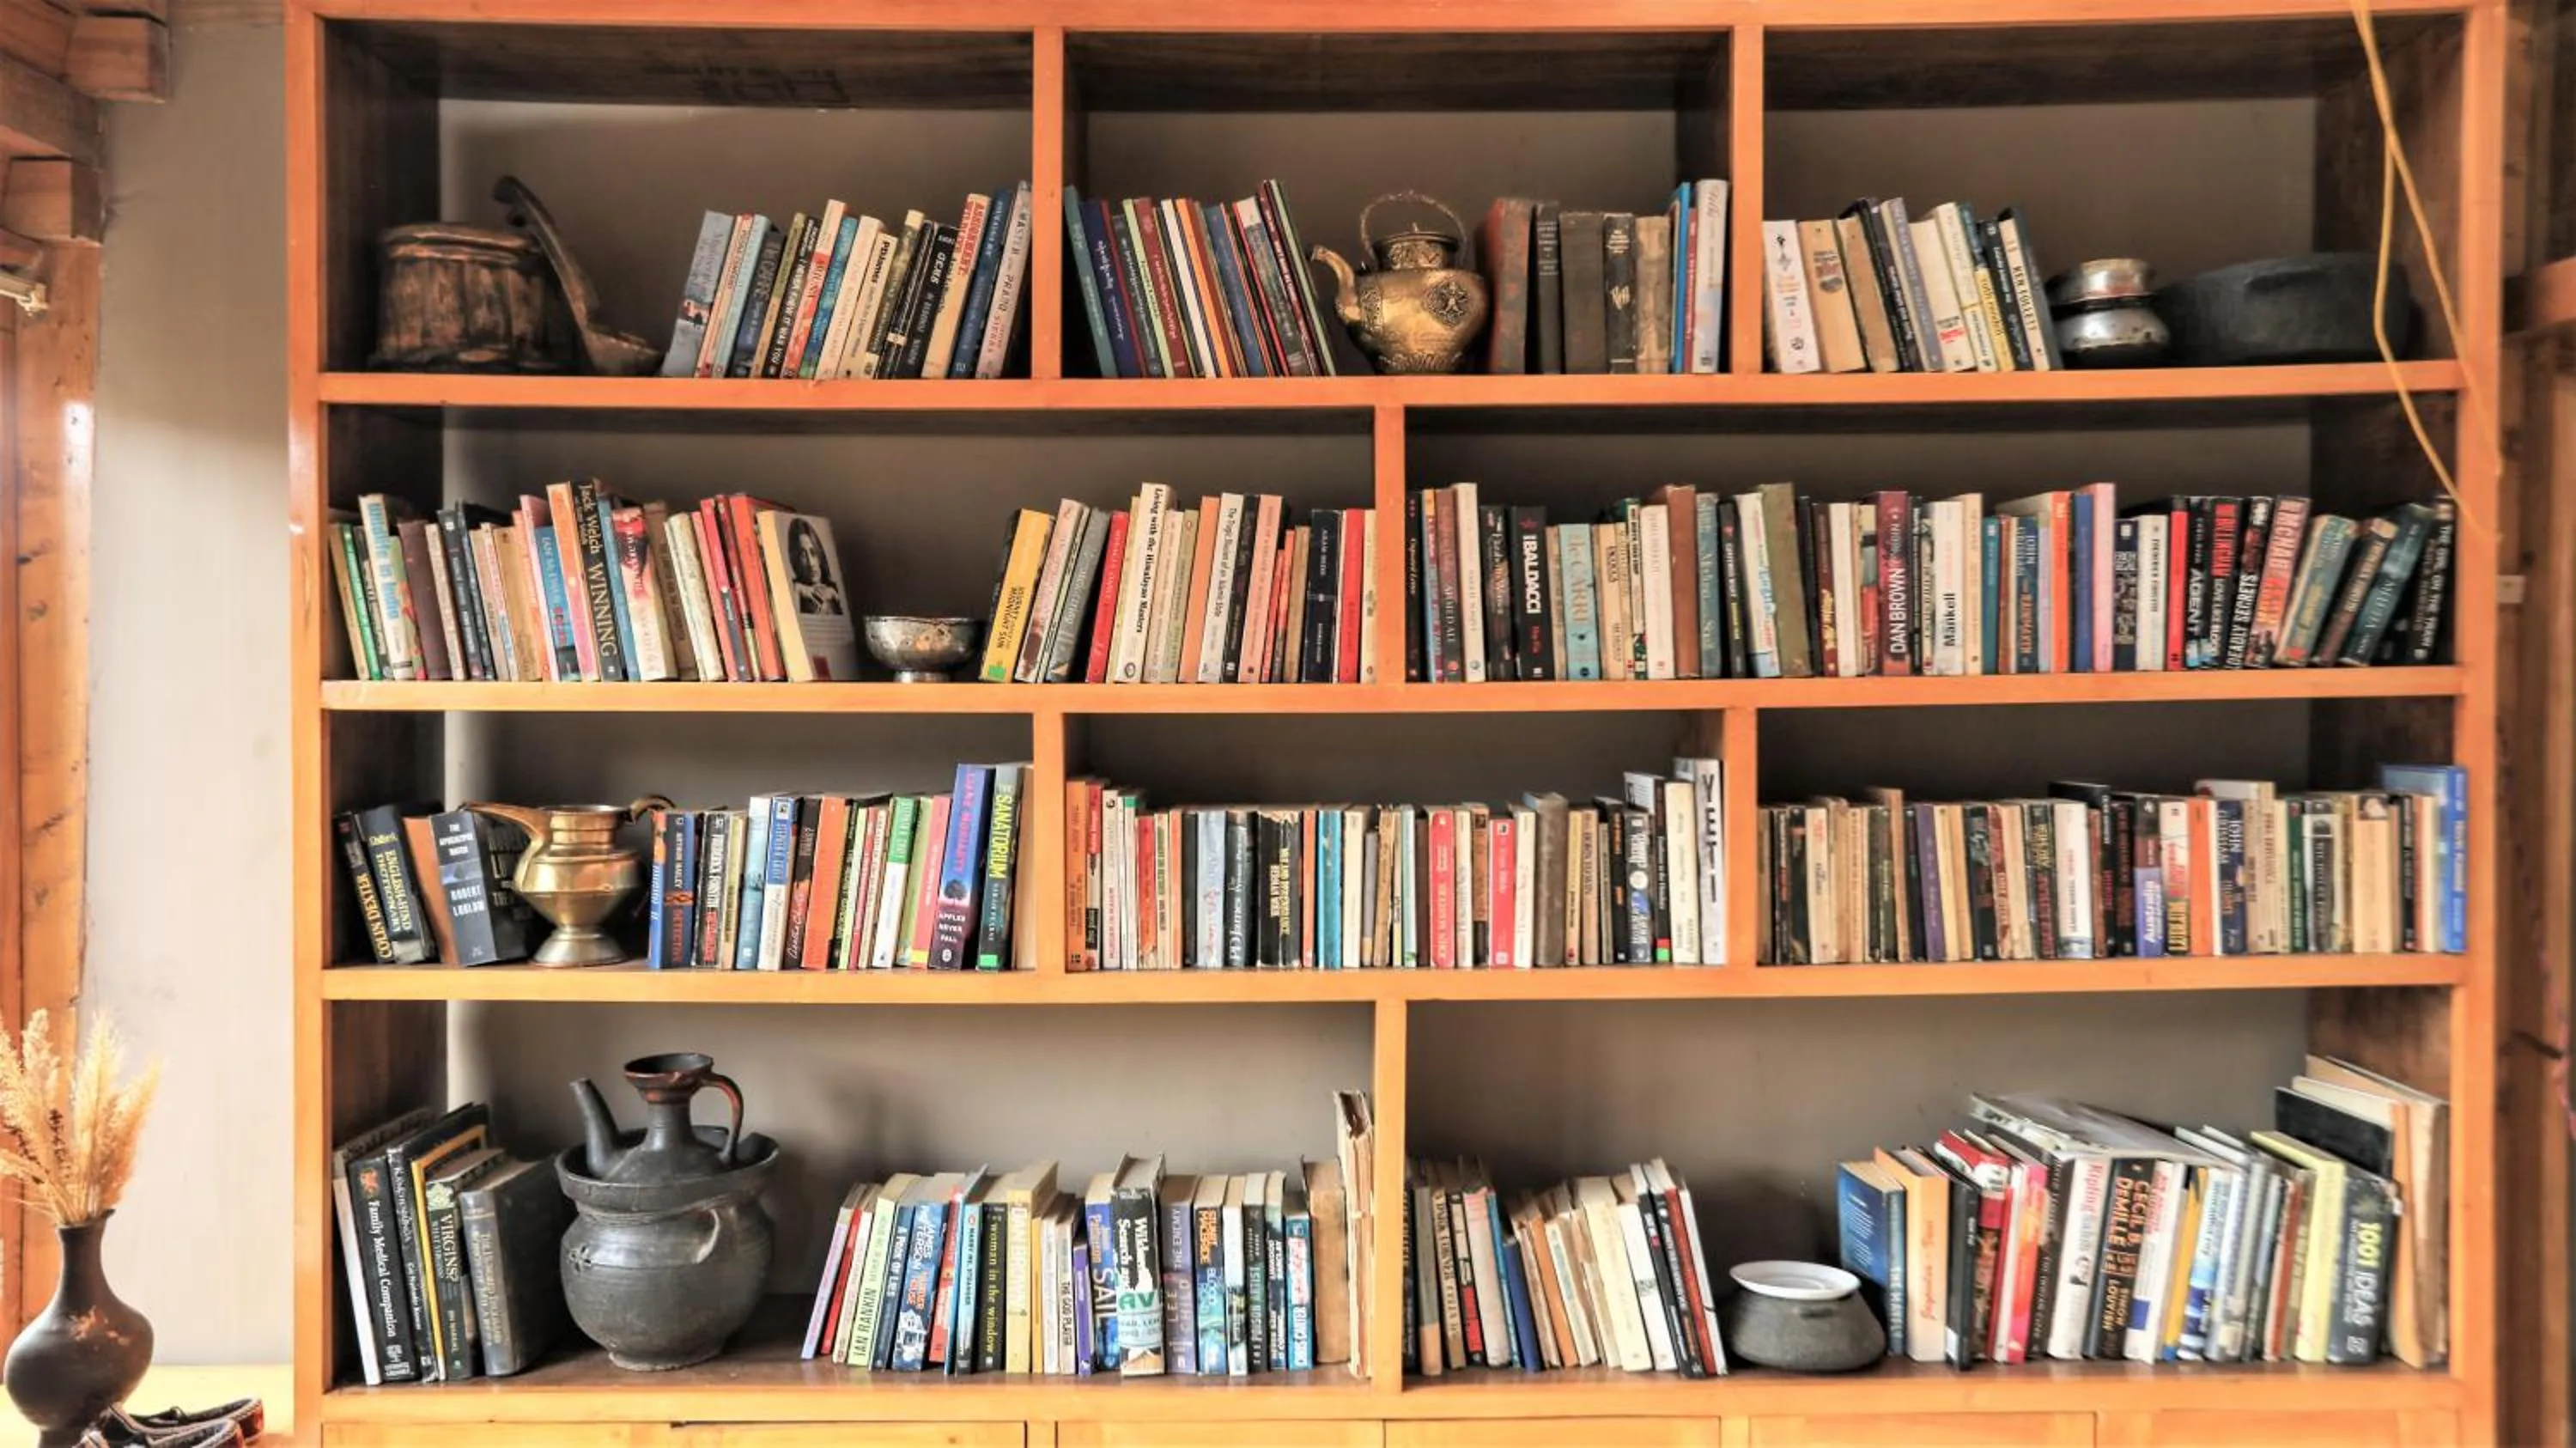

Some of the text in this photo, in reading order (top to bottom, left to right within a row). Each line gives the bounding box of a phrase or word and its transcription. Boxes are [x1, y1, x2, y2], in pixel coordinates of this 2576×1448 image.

[771, 347, 783, 364] YOU
[579, 484, 603, 555] Jack Welch
[1148, 515, 1162, 536] with
[1150, 486, 1165, 514] Living
[1139, 554, 1157, 599] Himalayan
[2026, 534, 2037, 565] JOHN
[1522, 540, 1542, 615] BALDACCI
[2187, 567, 2203, 636] AGENT
[2233, 573, 2258, 624] SECRETS
[588, 562, 617, 657] WINNING
[1135, 599, 1149, 634] Masters
[1443, 583, 1457, 642] AHMED ALI
[1888, 568, 1907, 654] DAN BROWN
[1942, 593, 1956, 648] Mankell
[674, 830, 683, 889] ARTHUR HAILEY
[987, 794, 1013, 879] SANATORIUM
[1703, 774, 1718, 903] YETI
[2217, 809, 2231, 864] GRISHAM
[2228, 818, 2245, 853] JOHN
[356, 872, 393, 958] COLIN DEXTER
[450, 885, 482, 901] ROBERT
[671, 909, 684, 963] DETECTIVE
[1207, 1209, 1218, 1247] STUART
[2107, 1176, 2133, 1248] DEMILLE
[2129, 1180, 2149, 1228] CECIL
[440, 1213, 461, 1282] VIRGINS?
[912, 1204, 930, 1271] PATTERSON
[922, 1223, 936, 1259] JAMES
[967, 1227, 975, 1252] MARRY
[1009, 1207, 1029, 1310] DAN BROWN
[1117, 1219, 1132, 1266] Search
[1171, 1208, 1182, 1270] THE ENEMY
[1198, 1209, 1211, 1265] MACBRIDE
[2356, 1221, 2383, 1269] 1001
[367, 1200, 398, 1337] Family Medical Companion
[907, 1276, 919, 1306] HOUSE
[915, 1271, 929, 1311] MURDER
[985, 1222, 999, 1354] woman in the window
[1091, 1266, 1118, 1321] SAIL
[1249, 1266, 1262, 1303] ARTIST
[853, 1287, 878, 1358] IAN RANKIN
[1168, 1289, 1178, 1323] LEE
[1250, 1305, 1263, 1342] POISON
[1292, 1305, 1308, 1340] CARTER
[1890, 1266, 1905, 1340] THE MAYFLY
[2100, 1278, 2119, 1332] LOUVISH
[2115, 1287, 2130, 1327] SIMON
[2350, 1270, 2379, 1327] IDEAS
